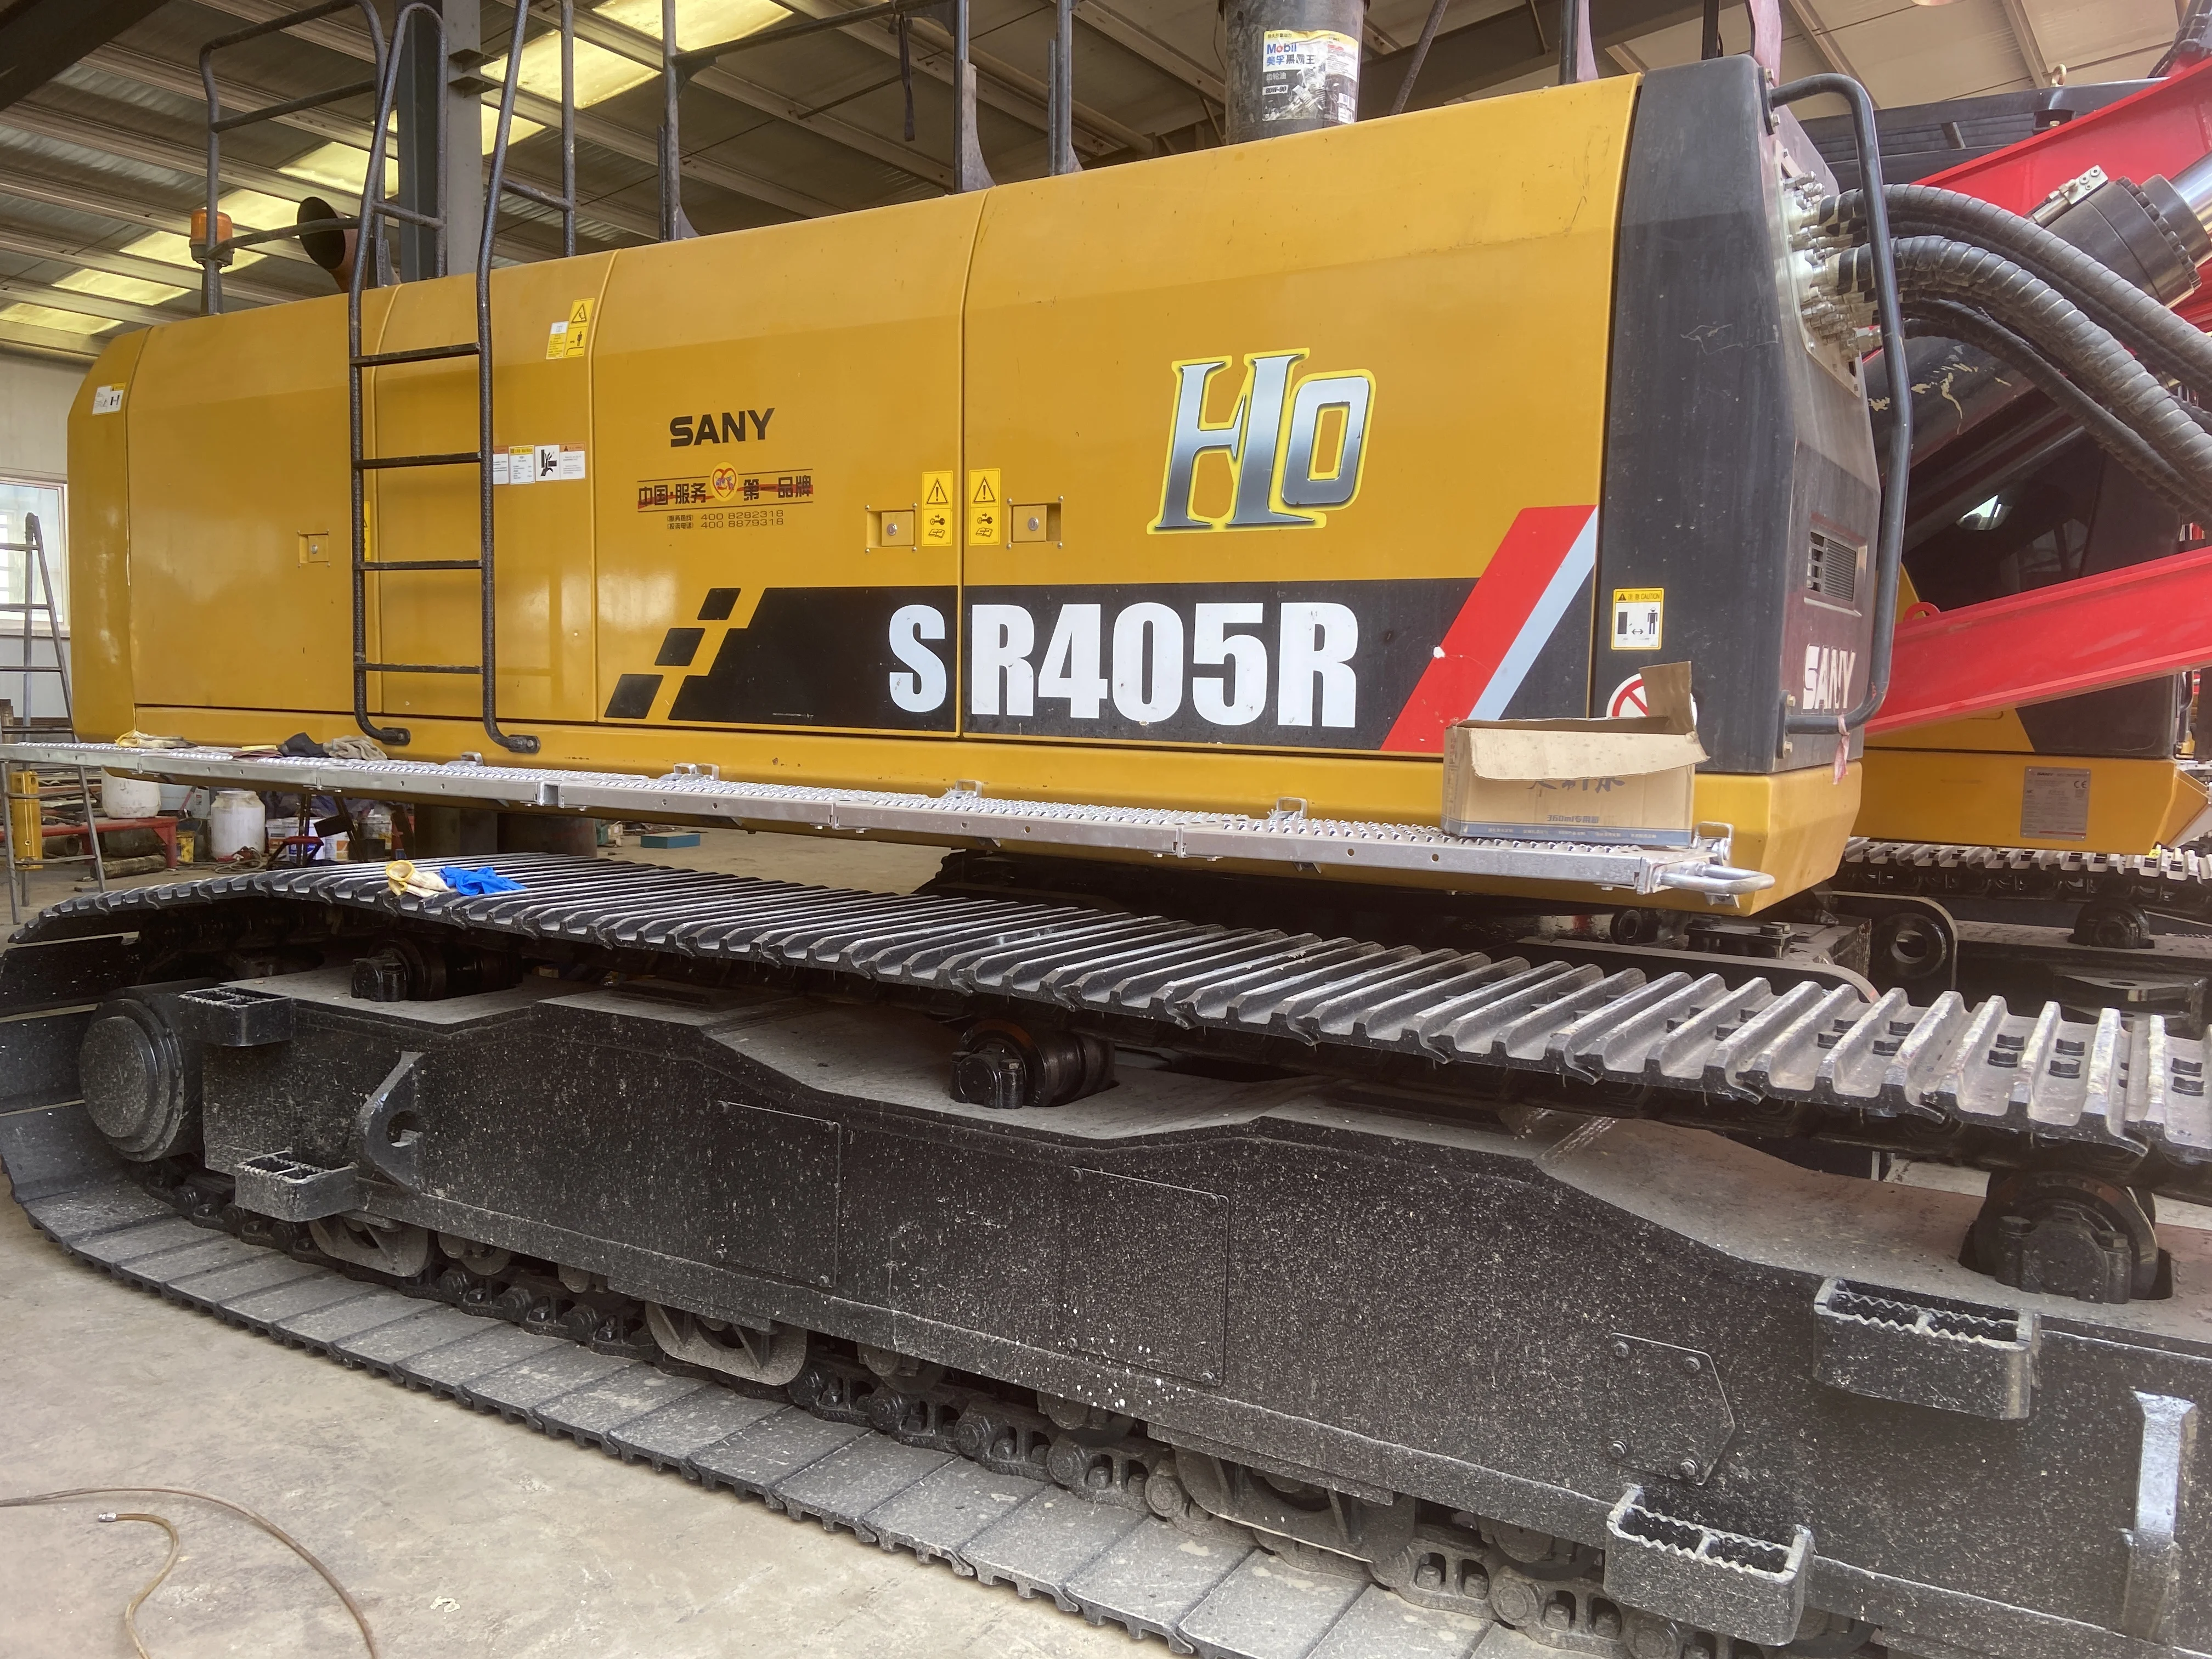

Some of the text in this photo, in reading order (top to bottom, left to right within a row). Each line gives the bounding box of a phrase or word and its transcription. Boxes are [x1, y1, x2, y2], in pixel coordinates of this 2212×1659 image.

[1267, 43, 1297, 54] Mobil
[670, 408, 775, 447] SANY
[743, 475, 811, 501] 第一品牌
[728, 510, 783, 519] 8282318
[728, 518, 783, 527] 8879318
[1803, 644, 1857, 709] SANY
